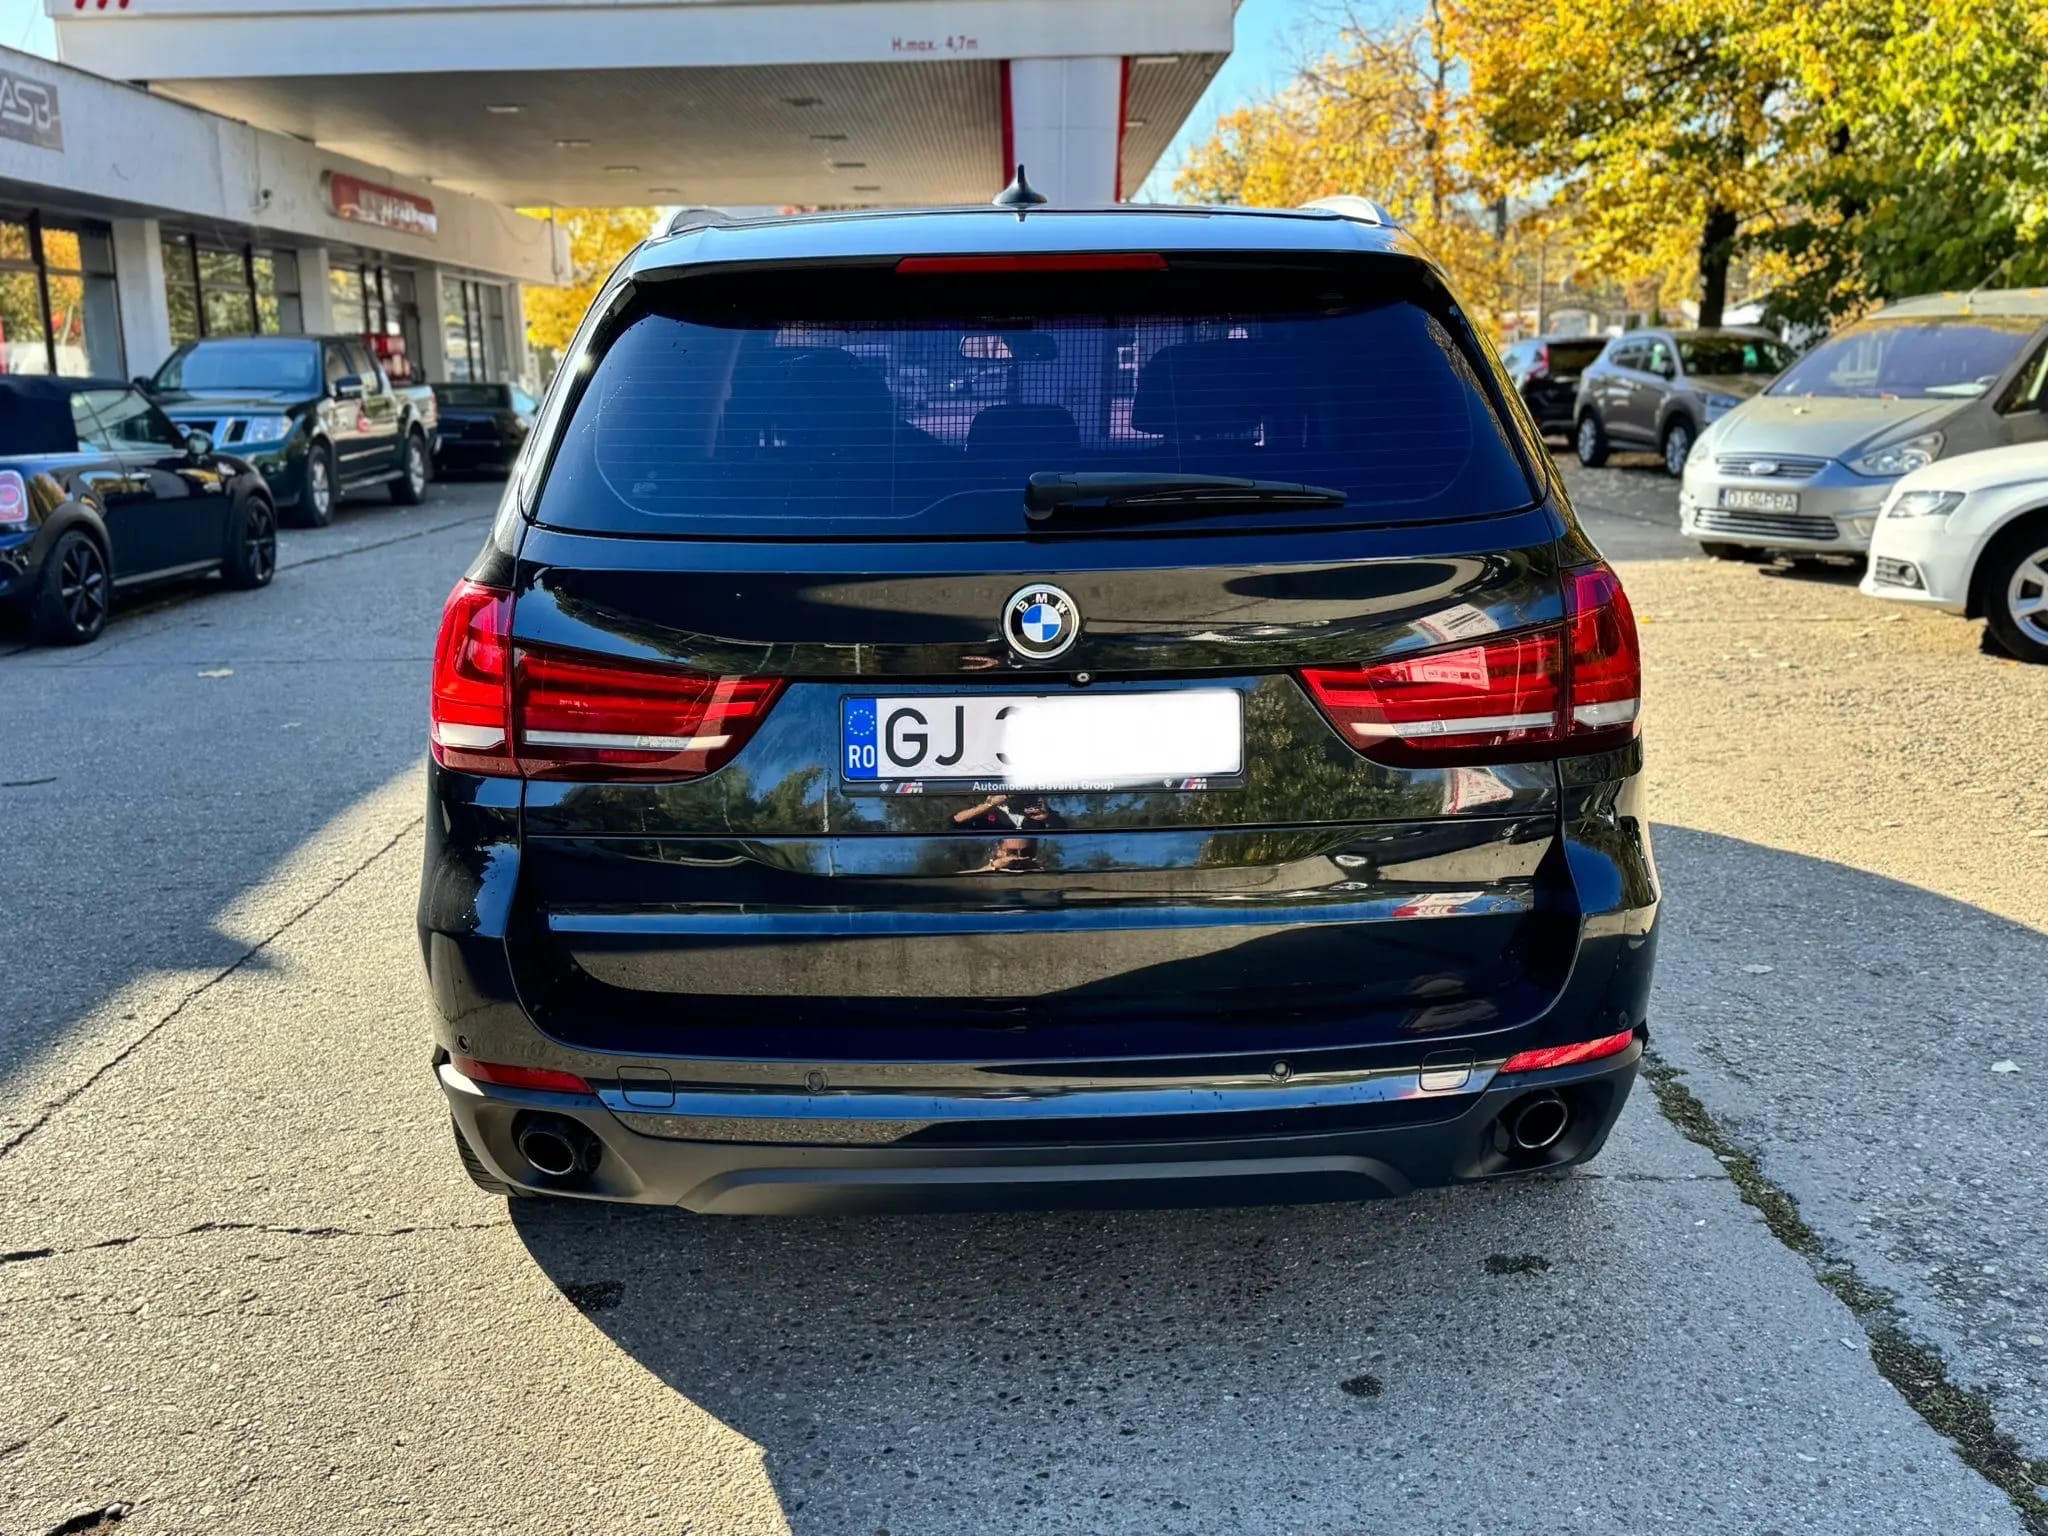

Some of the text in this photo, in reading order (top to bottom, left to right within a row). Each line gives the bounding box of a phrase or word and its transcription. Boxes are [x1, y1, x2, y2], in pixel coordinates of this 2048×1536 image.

[1016, 593, 1068, 615] BMW
[885, 705, 965, 768] GJ
[849, 744, 875, 768] RO
[1081, 781, 1115, 792] Group
